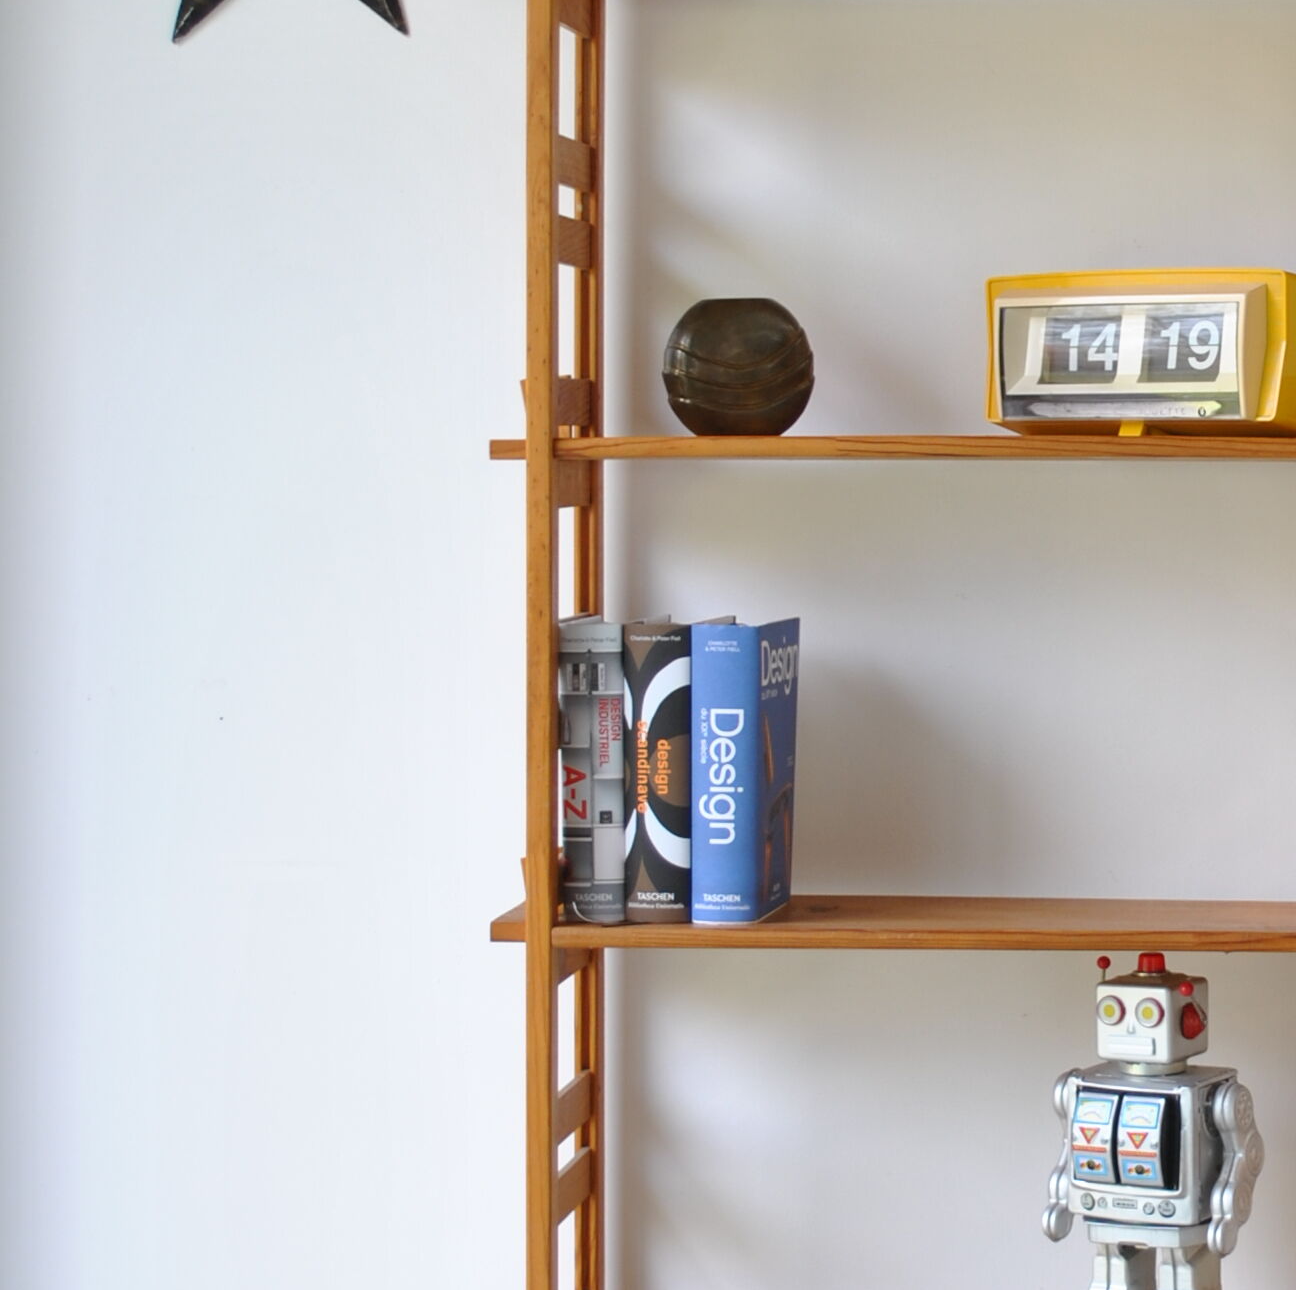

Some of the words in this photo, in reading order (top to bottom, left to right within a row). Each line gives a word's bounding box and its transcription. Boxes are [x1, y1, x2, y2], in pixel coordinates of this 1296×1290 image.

[1061, 322, 1119, 372] 14
[1160, 320, 1221, 371] 19
[598, 698, 609, 768] INDUSTRIEL
[611, 697, 622, 741] DESIGN
[563, 764, 587, 821] A-Z
[636, 720, 650, 814] scandinave
[653, 739, 672, 795] design
[699, 708, 745, 845] Design
[637, 892, 675, 901] TASCHEN
[703, 893, 741, 902] TASCHEN
